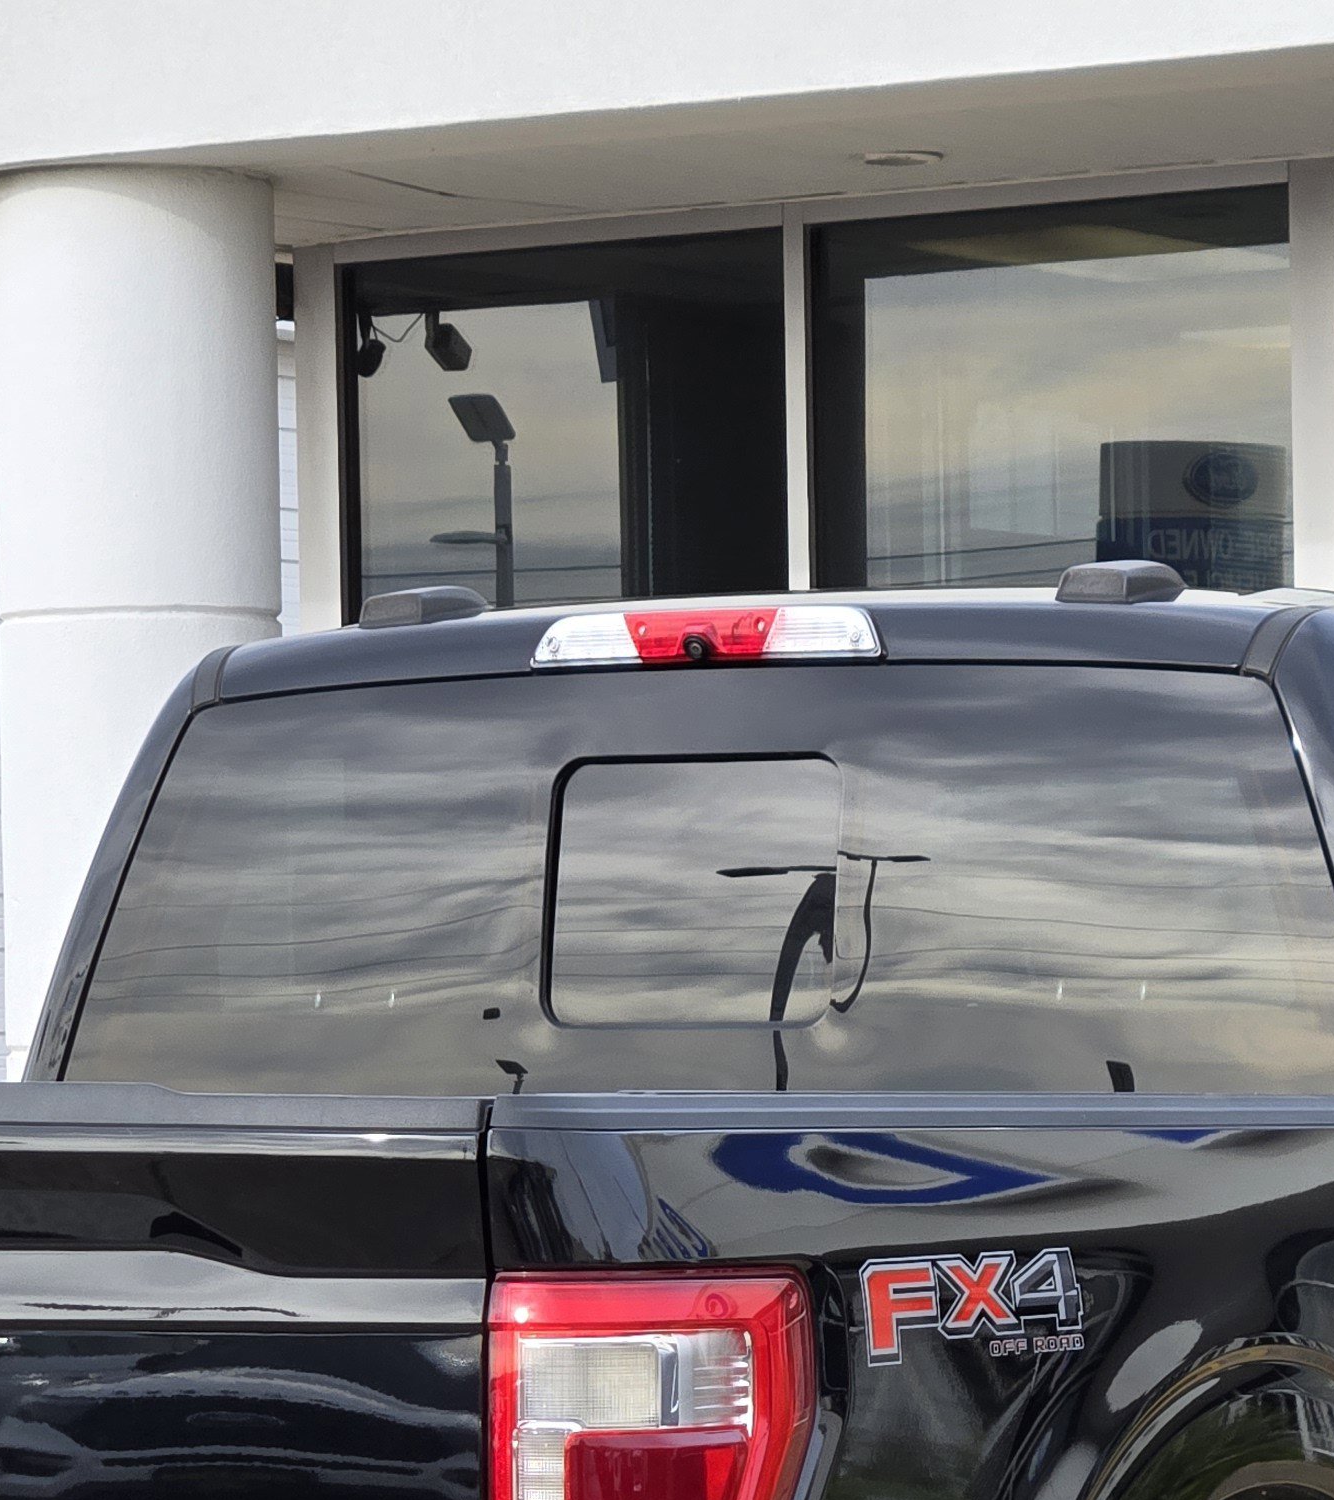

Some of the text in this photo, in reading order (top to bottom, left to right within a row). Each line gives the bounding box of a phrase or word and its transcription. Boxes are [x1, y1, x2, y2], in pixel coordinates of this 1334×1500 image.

[858, 1247, 1084, 1367] FX4
[989, 1333, 1085, 1357] OFF ROAD
